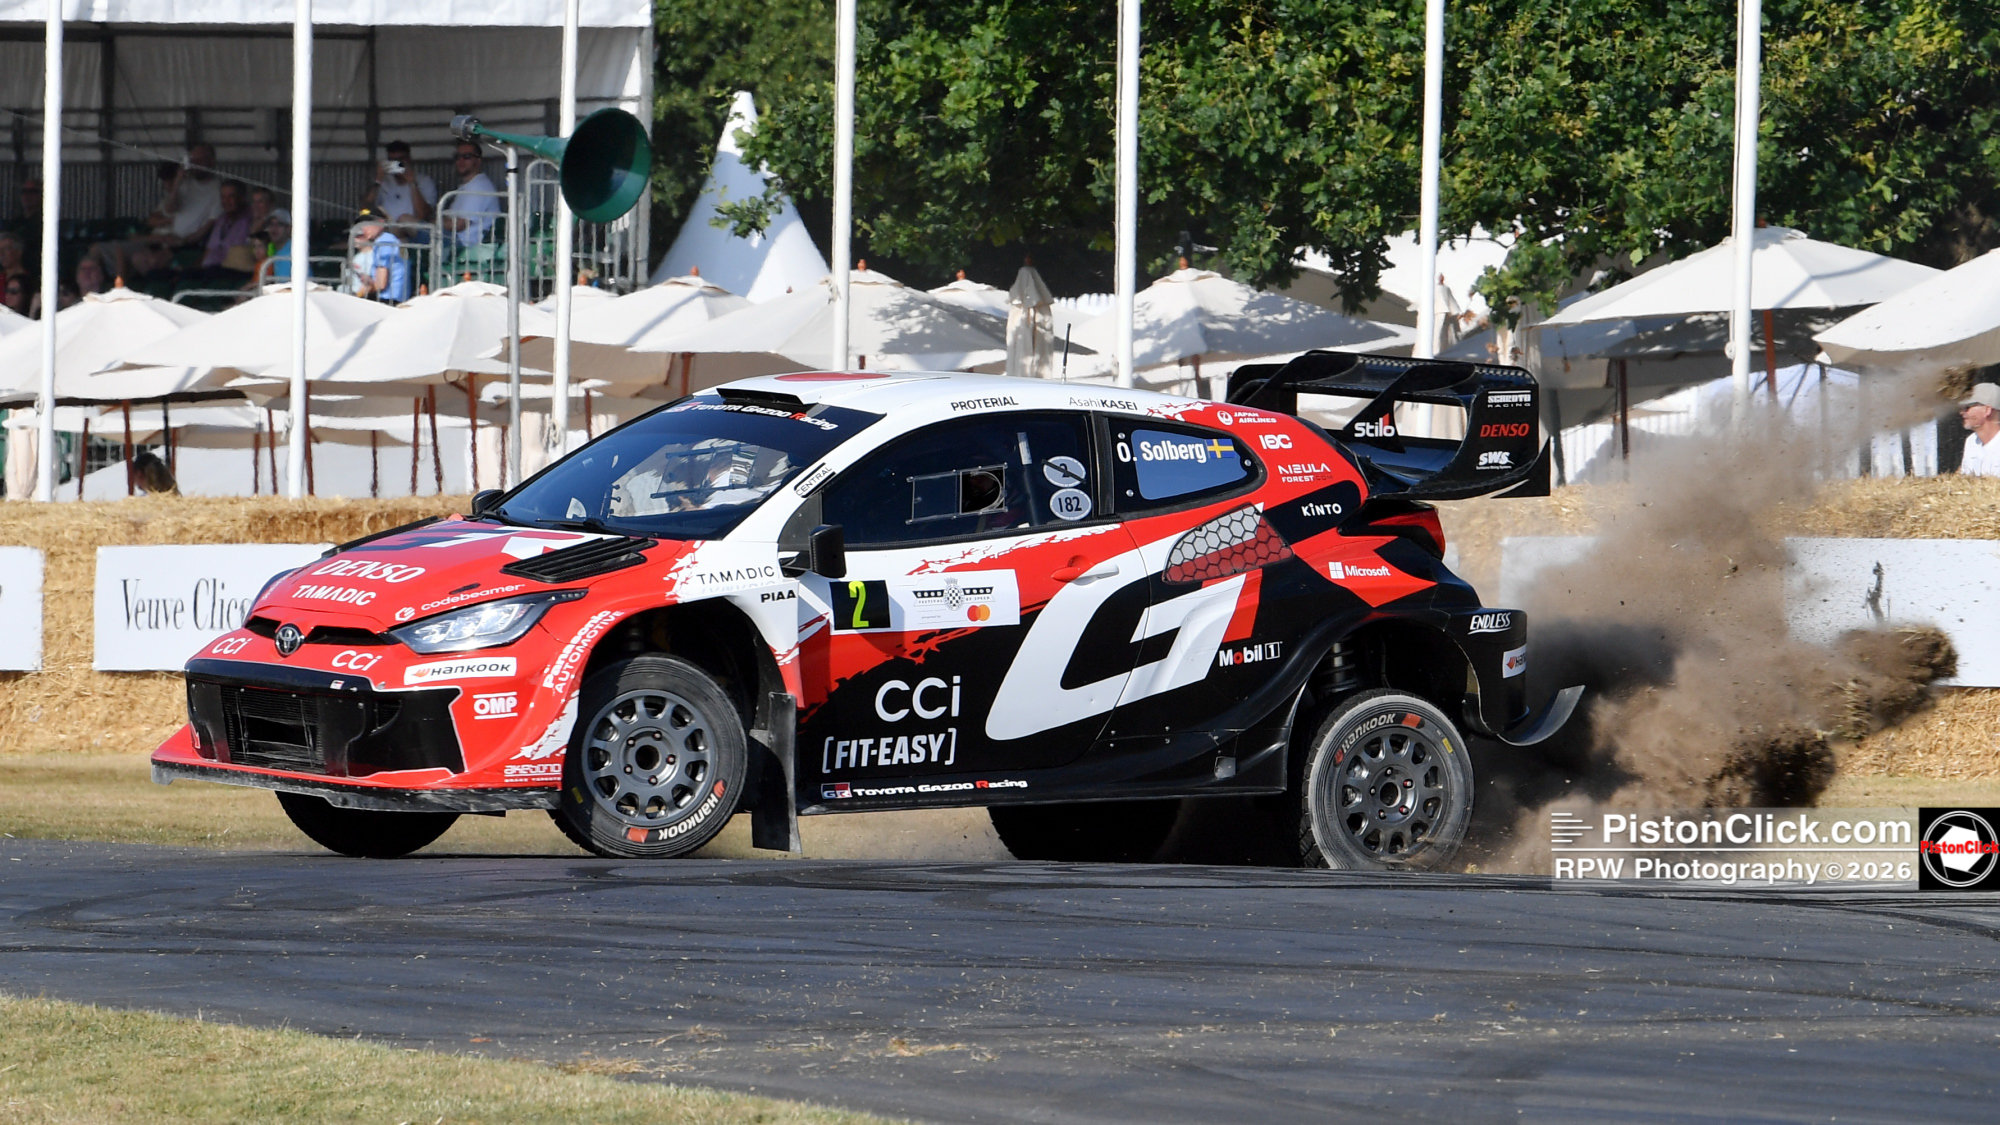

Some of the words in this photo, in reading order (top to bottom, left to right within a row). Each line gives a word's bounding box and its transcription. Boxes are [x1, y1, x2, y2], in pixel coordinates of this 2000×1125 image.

[950, 396, 1019, 412] PROTERIAL
[788, 411, 839, 431] Racing
[1354, 413, 1396, 438] Stilo
[1480, 423, 1531, 438] DENSO
[1116, 441, 1138, 463] O.
[1140, 439, 1207, 464] Solberg
[795, 465, 834, 498] CENTRAL
[1057, 496, 1083, 514] 182
[311, 559, 426, 583] DENSO
[696, 565, 775, 585] TAMADIC
[1344, 564, 1391, 577] Microsoft
[121, 578, 185, 631] Veuve
[291, 584, 377, 606] TAMADIC
[421, 584, 521, 611] codebeamer
[760, 589, 797, 604] PIAA
[848, 580, 870, 628] 2
[1469, 611, 1512, 631] ENDLESS
[542, 609, 612, 689] Panasonic
[554, 610, 625, 693] AUTOMOTIVE
[1218, 643, 1263, 668] Mobil
[473, 695, 518, 715] OMP
[853, 786, 917, 797] TOYOTA
[975, 779, 1028, 790] Racing
